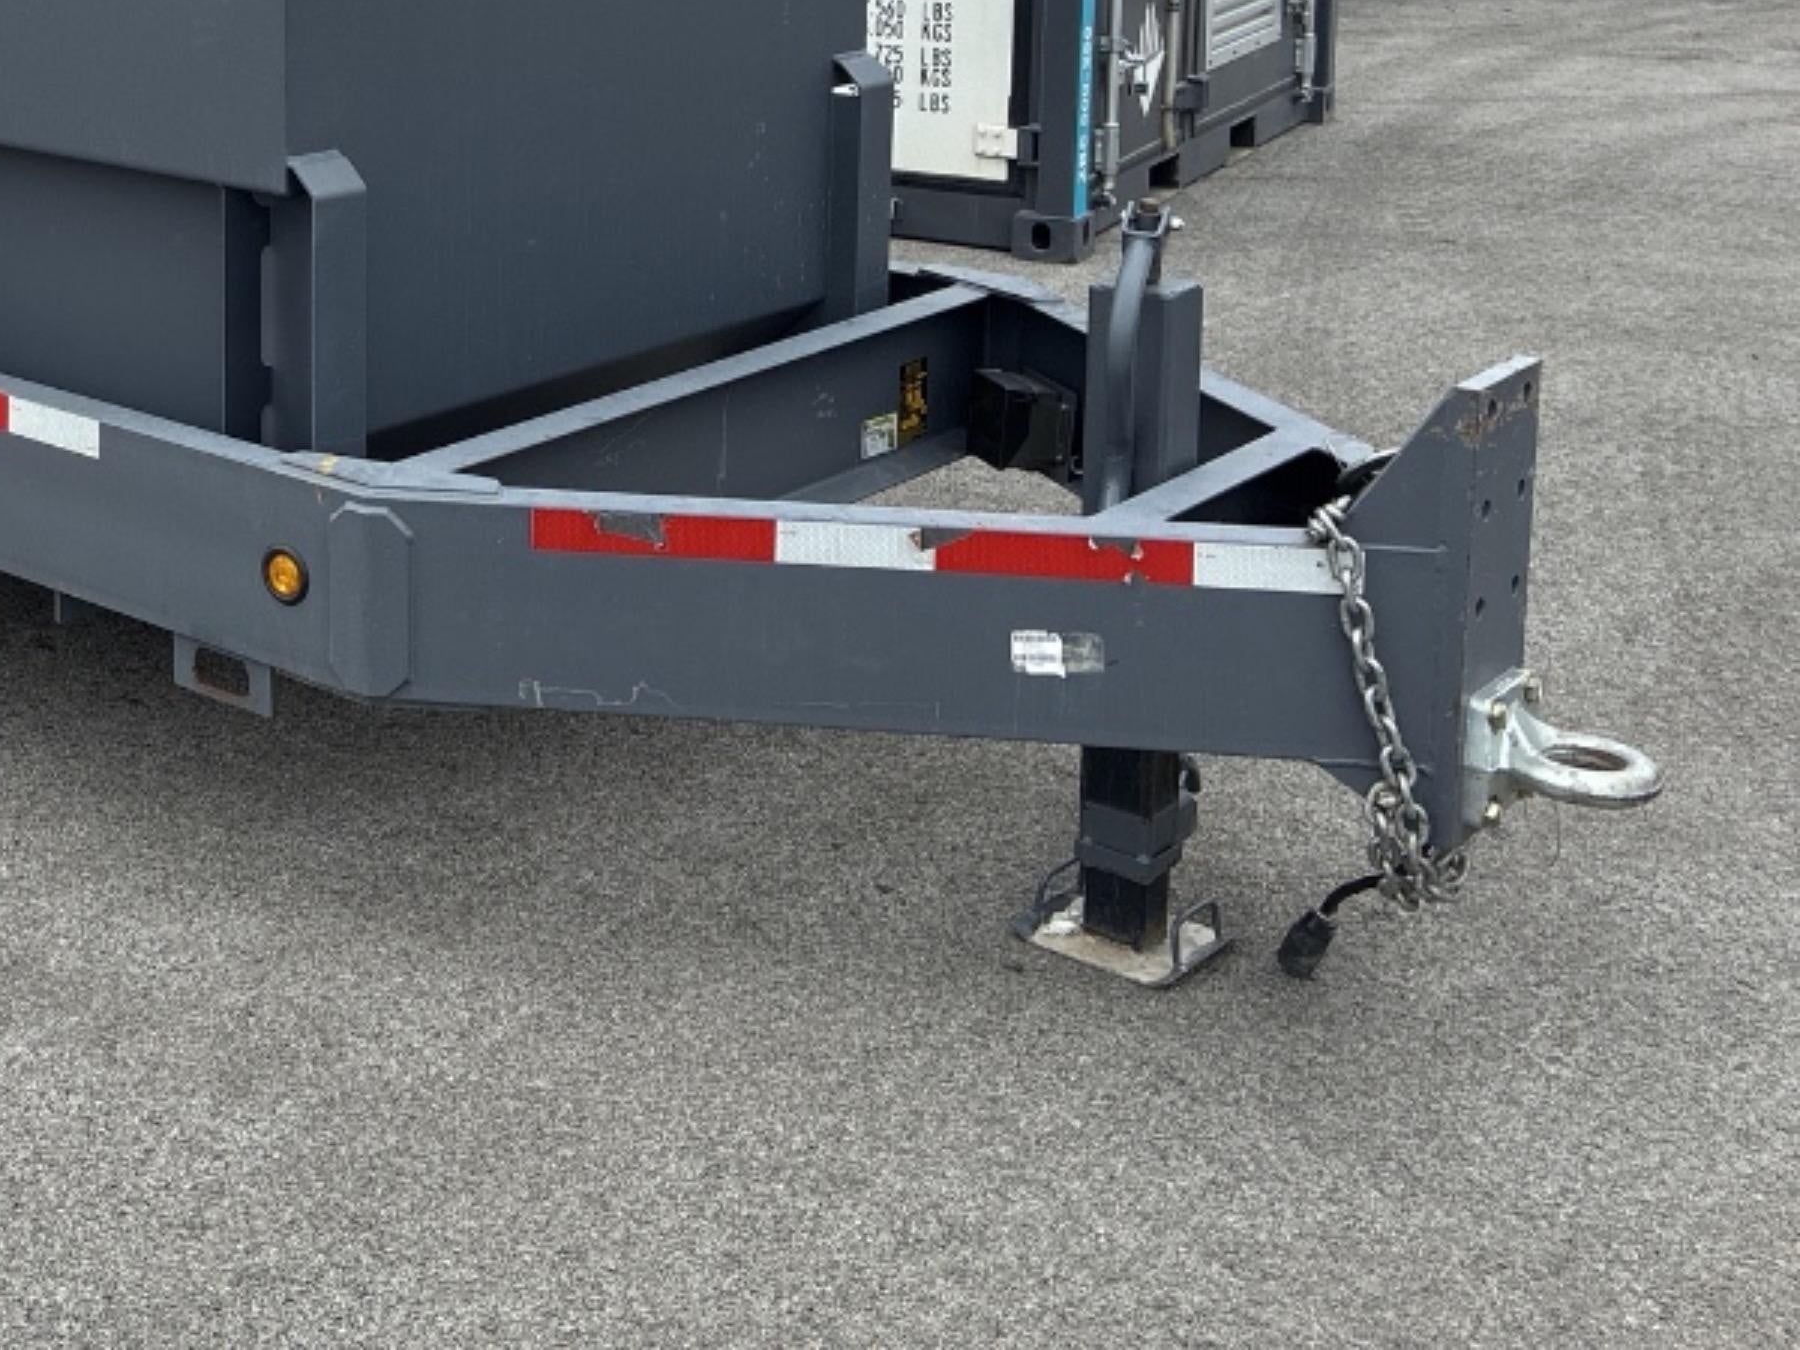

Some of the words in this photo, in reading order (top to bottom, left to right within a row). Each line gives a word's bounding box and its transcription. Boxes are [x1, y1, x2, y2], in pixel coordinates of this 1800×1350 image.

[923, 1, 954, 22] LBS
[920, 22, 952, 43] KGS
[920, 46, 952, 68] LBS
[919, 67, 952, 88] KGS
[917, 92, 950, 114] LBS
